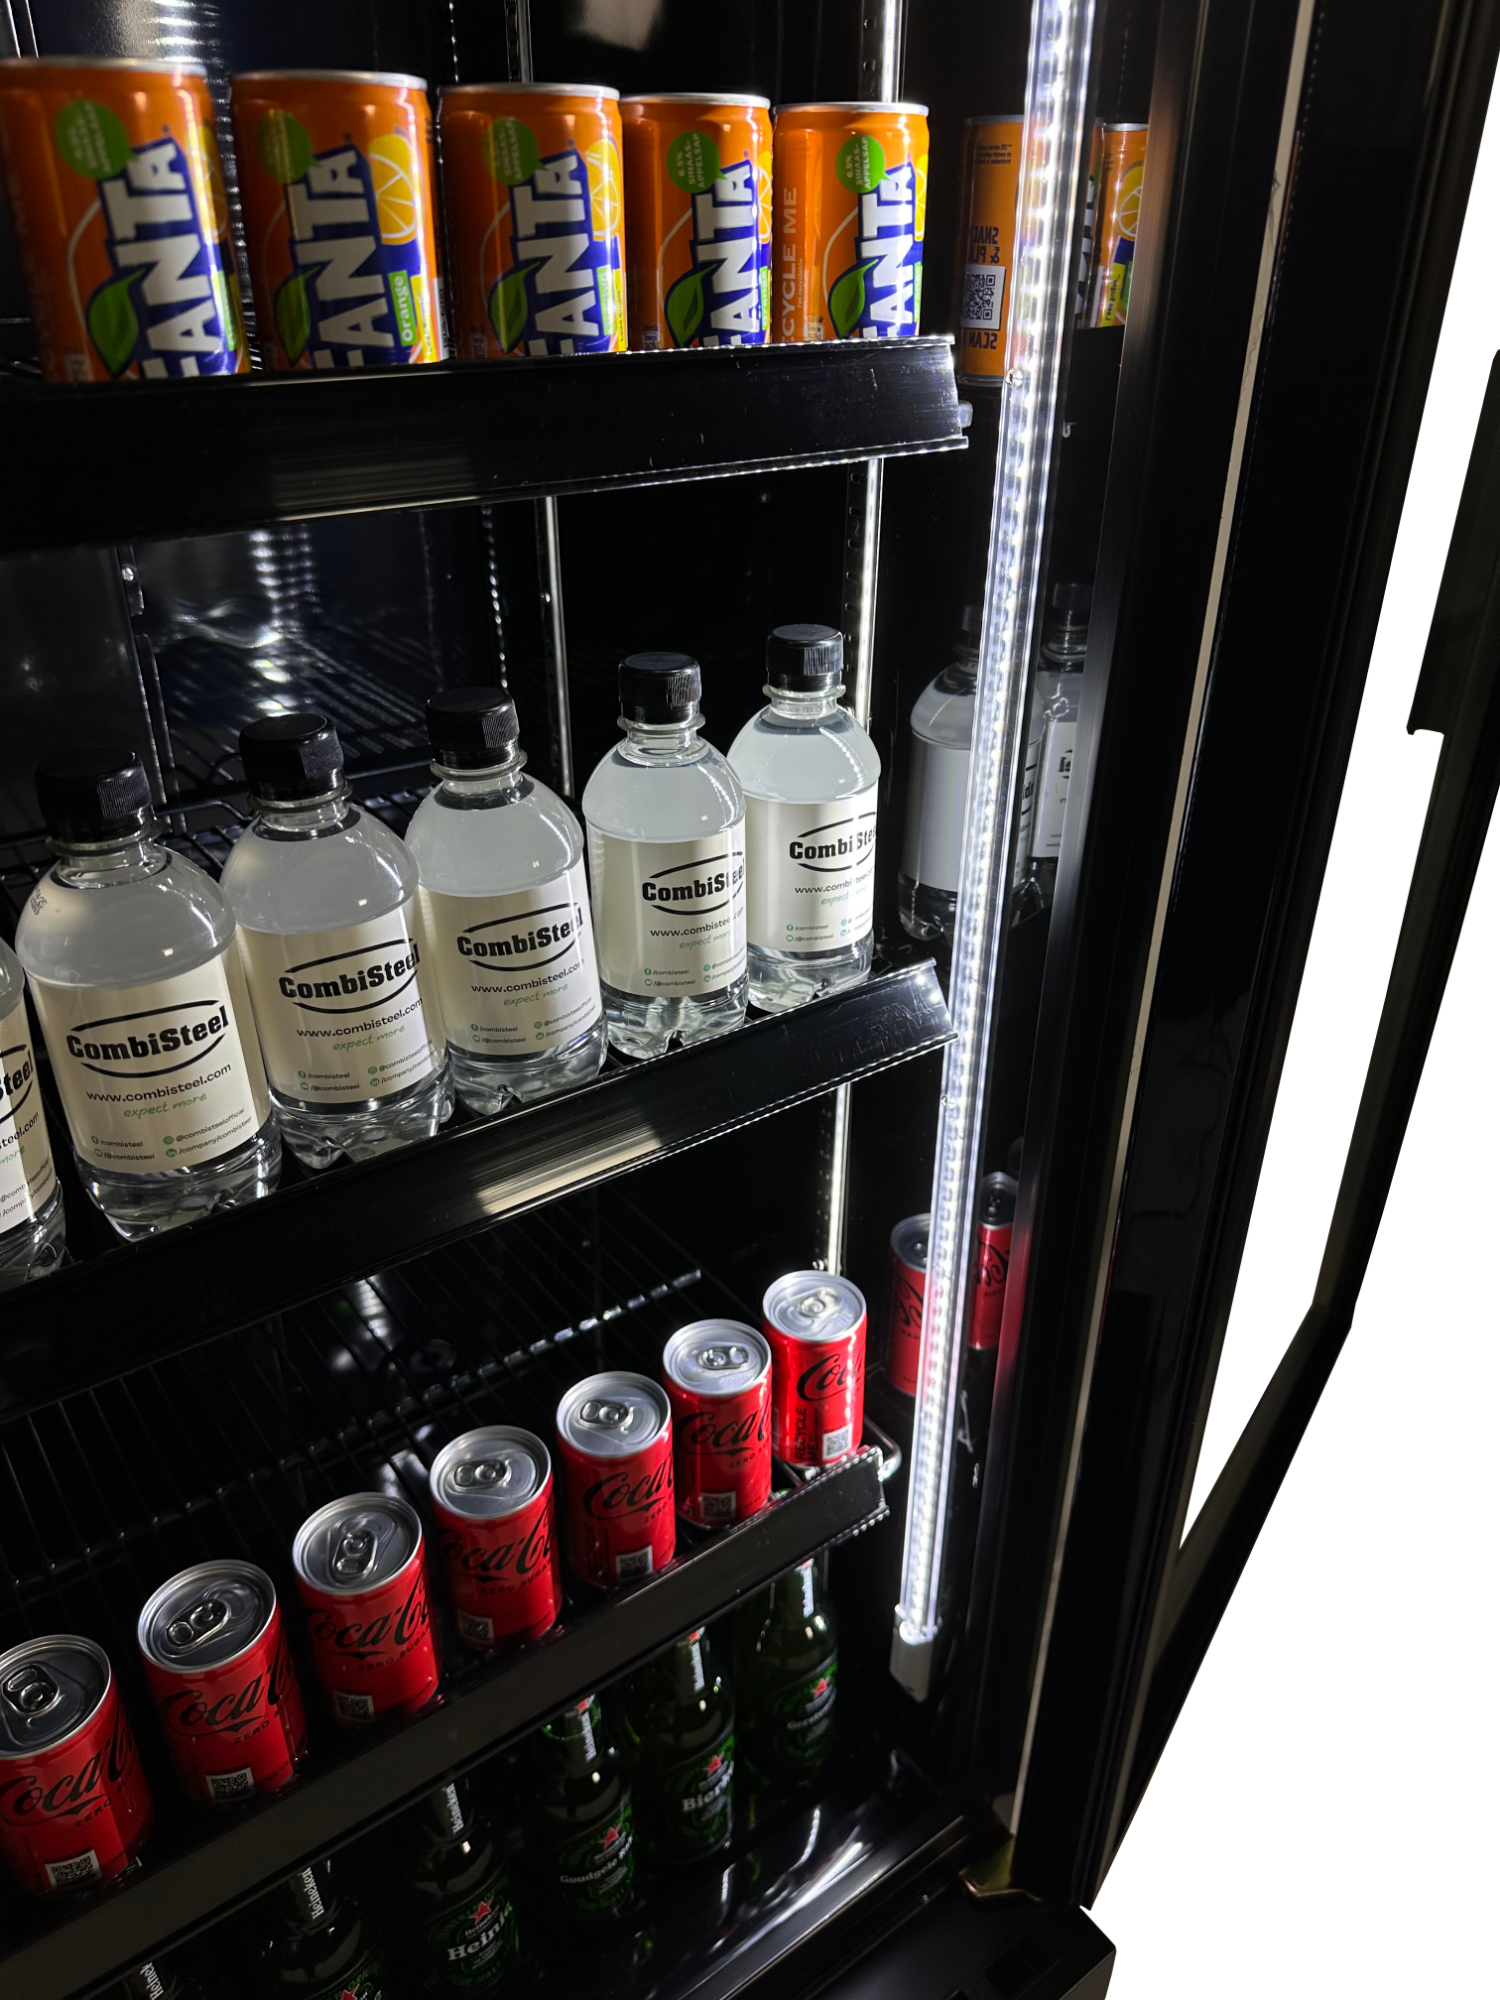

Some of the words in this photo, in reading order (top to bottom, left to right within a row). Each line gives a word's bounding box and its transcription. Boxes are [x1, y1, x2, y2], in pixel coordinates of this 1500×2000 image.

[681, 139, 694, 185] SINAAS-
[692, 132, 706, 188] APPELSAP
[855, 143, 864, 186] SINAAS-
[862, 136, 872, 189] APPELSAP
[782, 187, 798, 234] ME
[394, 275, 413, 343] Orange
[679, 935, 711, 950] expect
[278, 942, 421, 999] CombiSteel
[503, 993, 541, 1007] expect
[542, 982, 569, 998] more
[66, 1005, 229, 1060] CombiSteel
[296, 997, 424, 1038] www.combisteel.com
[332, 1036, 374, 1052] expect
[376, 1024, 406, 1043] more
[86, 1063, 231, 1103] www.combisteel.com
[123, 1101, 169, 1120] expect
[172, 1091, 208, 1110] more
[100, 1139, 144, 1149] /combisteel
[795, 1406, 806, 1461] RECYCLE
[728, 1452, 756, 1468] ZERO
[358, 1657, 395, 1671] ZERO
[233, 1719, 270, 1745] ZERO
[74, 1798, 112, 1829] ZERO
[301, 1866, 326, 1920] Heineken
